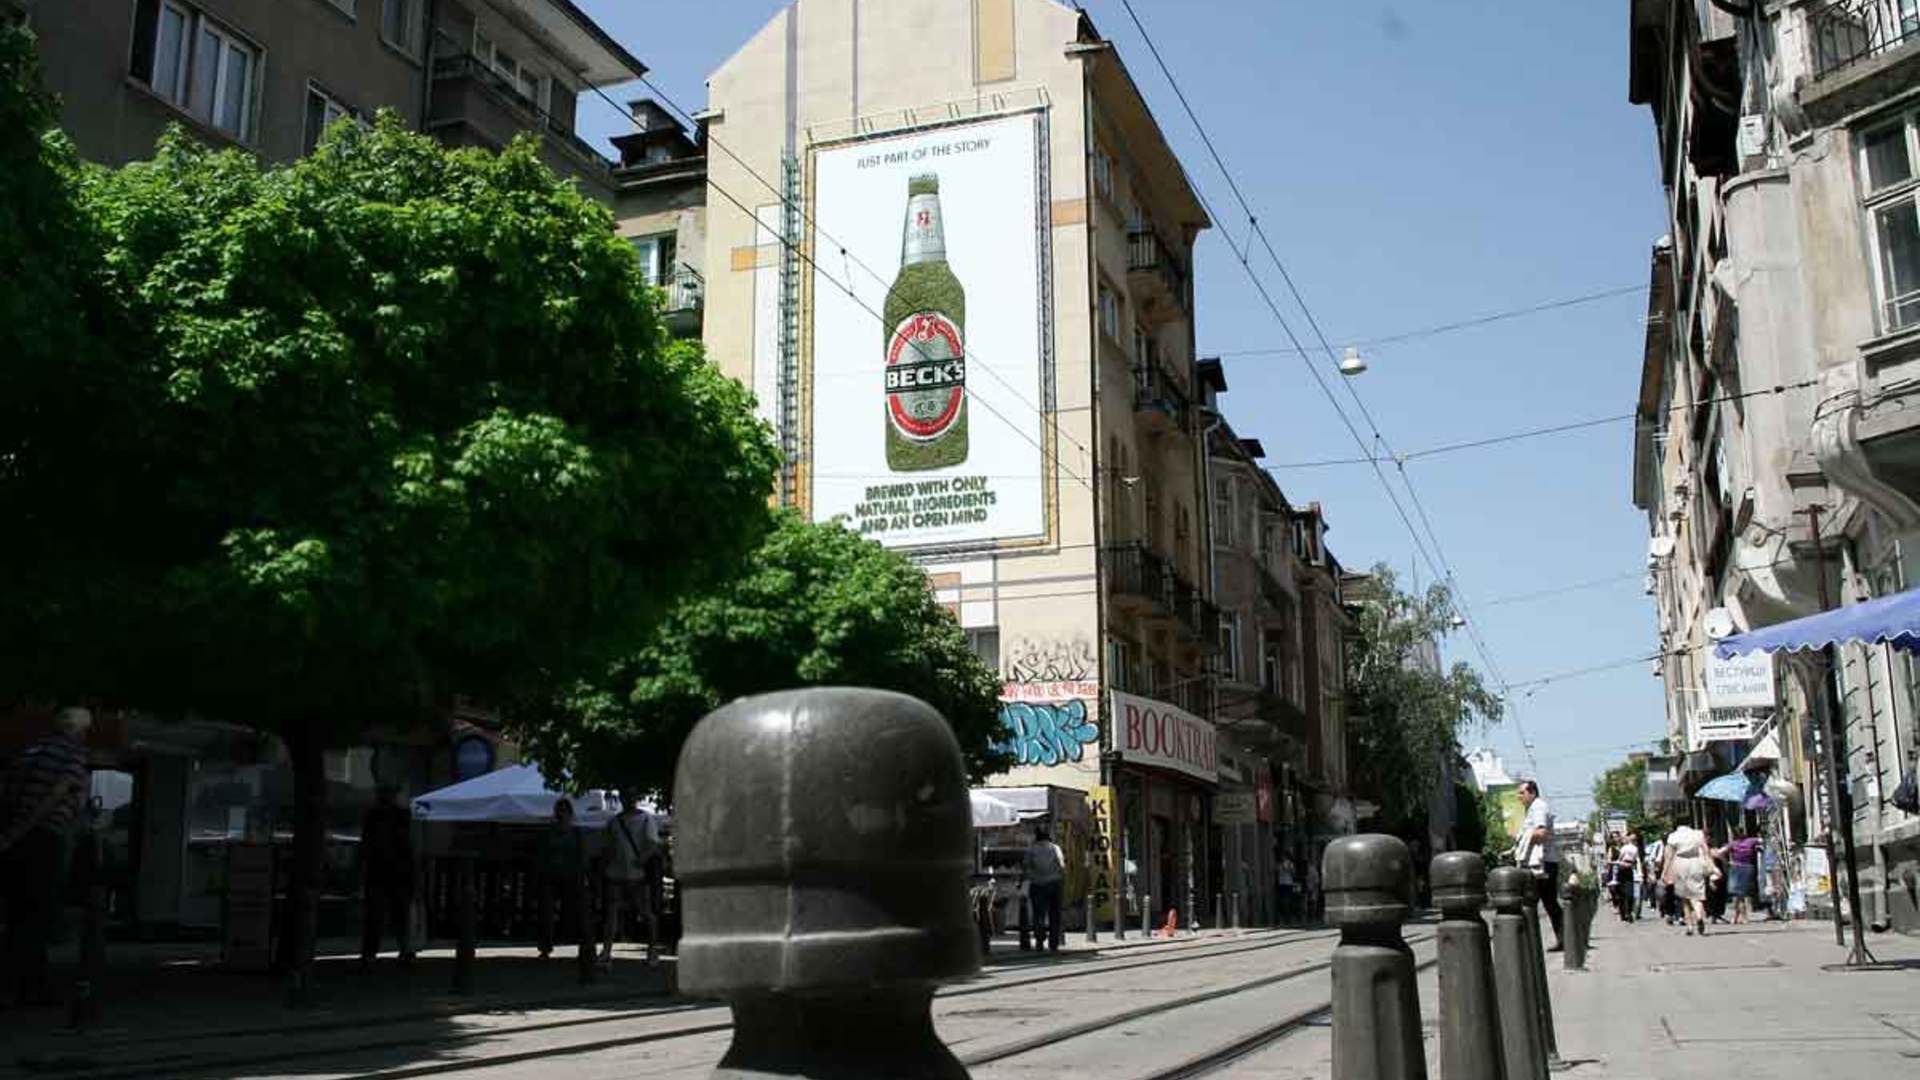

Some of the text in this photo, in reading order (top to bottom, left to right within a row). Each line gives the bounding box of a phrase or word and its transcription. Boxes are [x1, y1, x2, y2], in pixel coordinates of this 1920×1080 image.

[857, 139, 990, 168] JUST PART OF THE STORY
[887, 361, 964, 388] BECK'S
[865, 476, 988, 500] BREWED WITH ONLY
[855, 491, 996, 517] NATURAL INGREDIENTS
[860, 508, 988, 533] AND AN OPEN MIND
